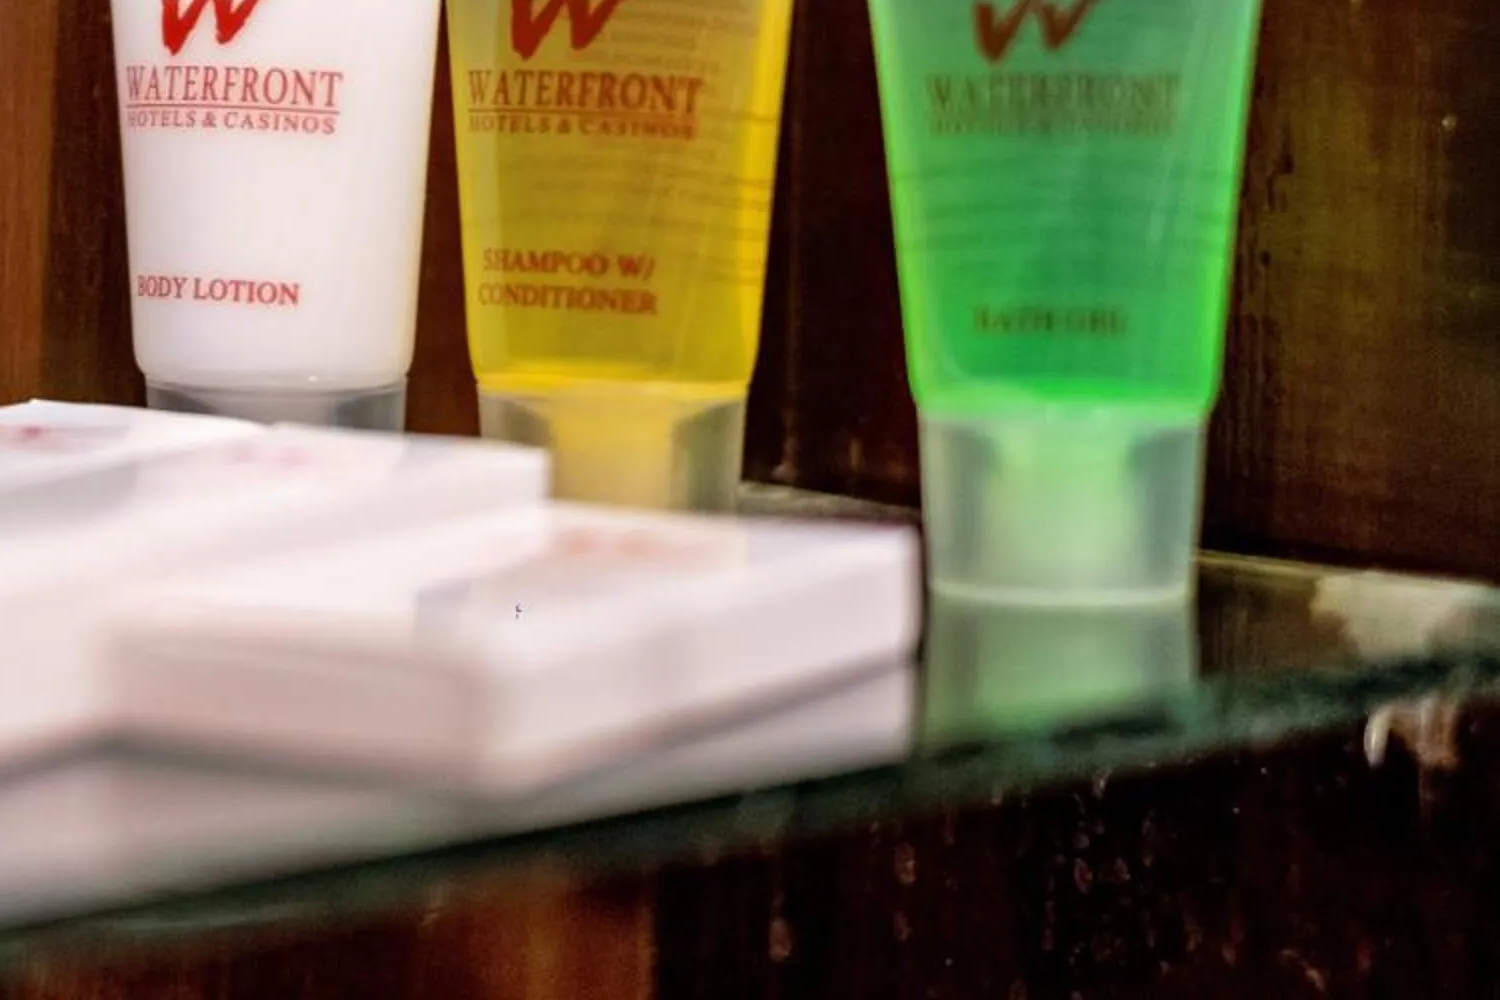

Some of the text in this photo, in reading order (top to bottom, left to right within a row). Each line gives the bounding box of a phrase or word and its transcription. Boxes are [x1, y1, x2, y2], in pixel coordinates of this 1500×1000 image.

[125, 64, 344, 107] WATERFRONT
[467, 68, 705, 114] WATERFRONT
[127, 109, 336, 135] HOTELS & CASINOS
[468, 113, 551, 135] HOTELS
[483, 248, 610, 277] SHAMPOO
[135, 274, 301, 305] BODY LOTION
[478, 282, 658, 315] CONDITIONER
